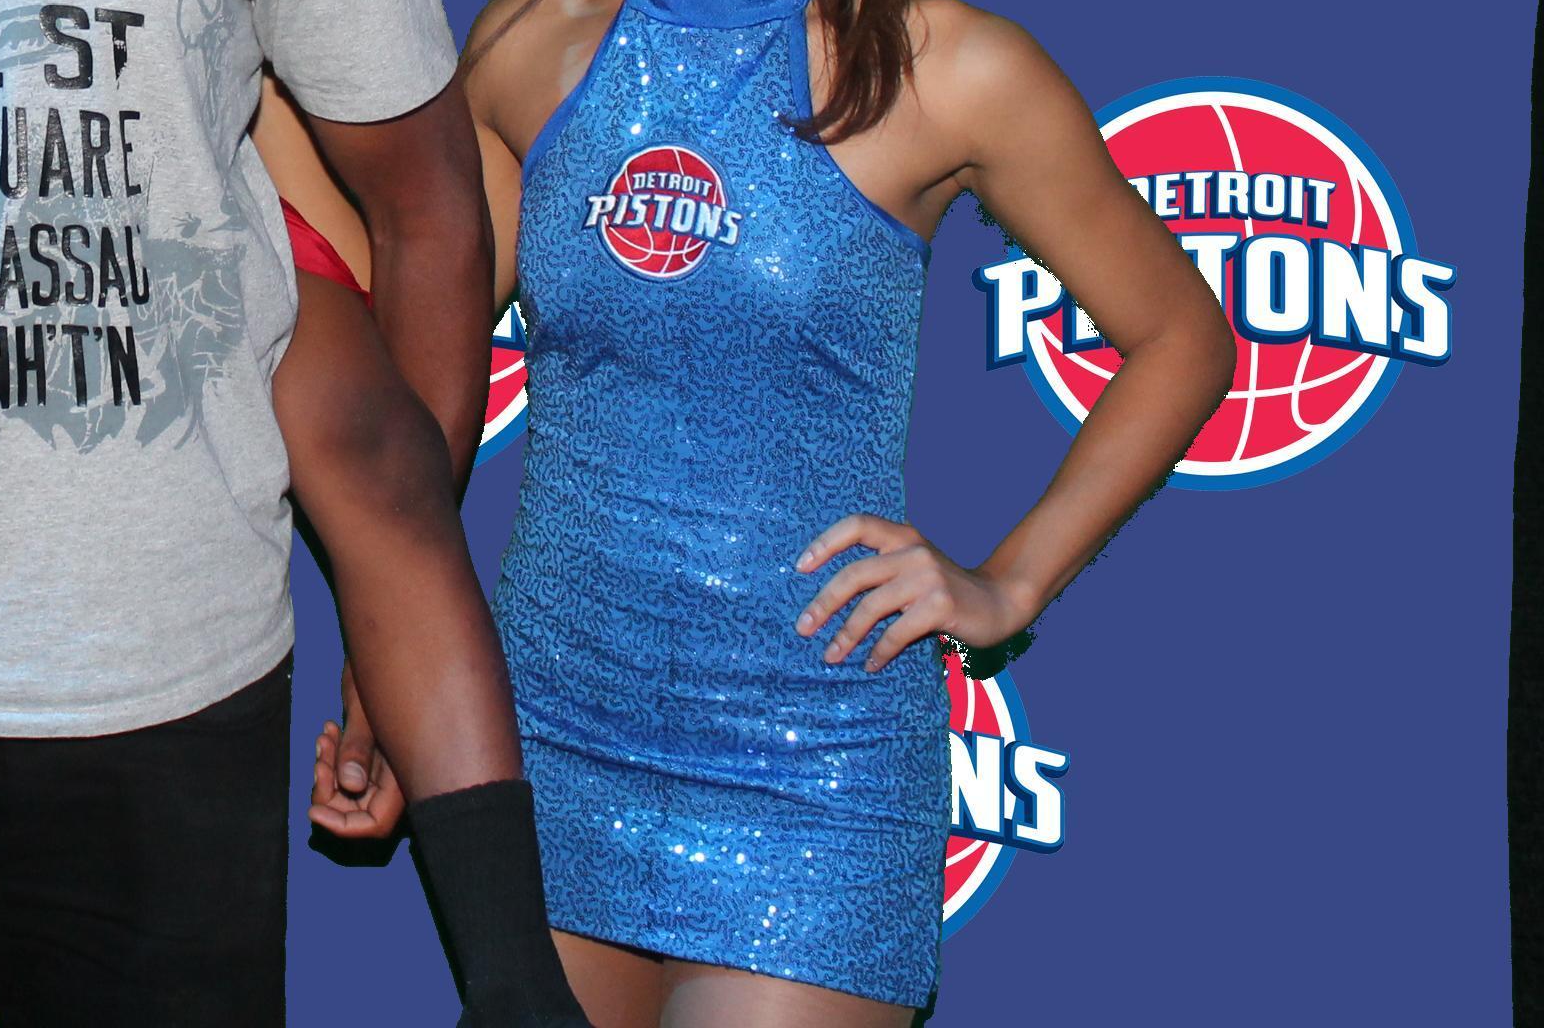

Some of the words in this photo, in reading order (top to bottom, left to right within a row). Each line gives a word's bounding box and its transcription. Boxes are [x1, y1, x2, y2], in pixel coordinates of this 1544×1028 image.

[39, 4, 145, 89] ST
[632, 172, 713, 196] DETROIT
[1128, 170, 1336, 228] ETROIT
[585, 193, 742, 246] PISTONS
[974, 232, 1456, 369] PTONS
